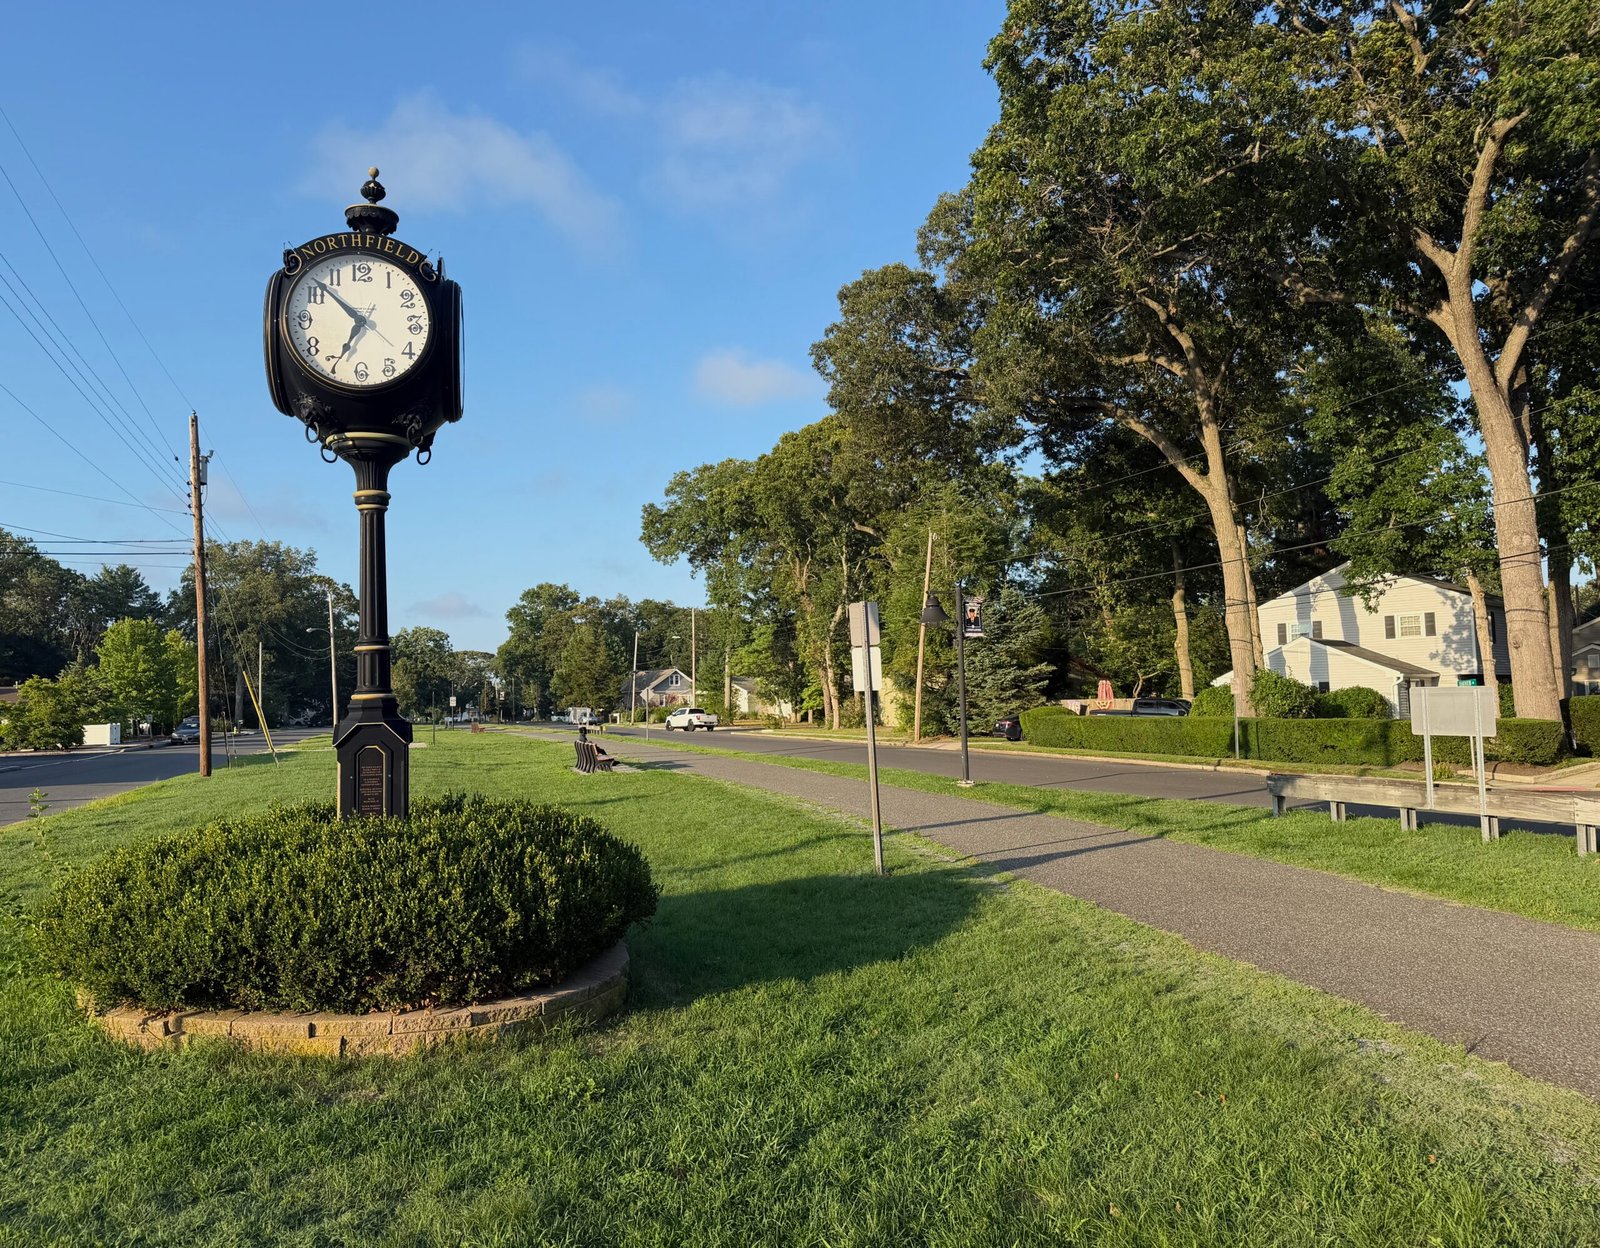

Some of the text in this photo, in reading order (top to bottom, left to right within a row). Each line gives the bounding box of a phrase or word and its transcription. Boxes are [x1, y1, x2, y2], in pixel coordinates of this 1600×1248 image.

[301, 234, 418, 264] NORTHFIELD
[329, 268, 341, 286] 11
[352, 263, 372, 282] 12
[386, 272, 391, 289] 1
[307, 286, 325, 304] 10
[400, 289, 416, 308] 2
[297, 309, 313, 329] 9
[407, 315, 423, 335] 3
[306, 336, 320, 356] 8
[401, 341, 415, 360] 4
[325, 354, 342, 374] 7
[354, 362, 369, 382] 6
[382, 358, 396, 377] 5
